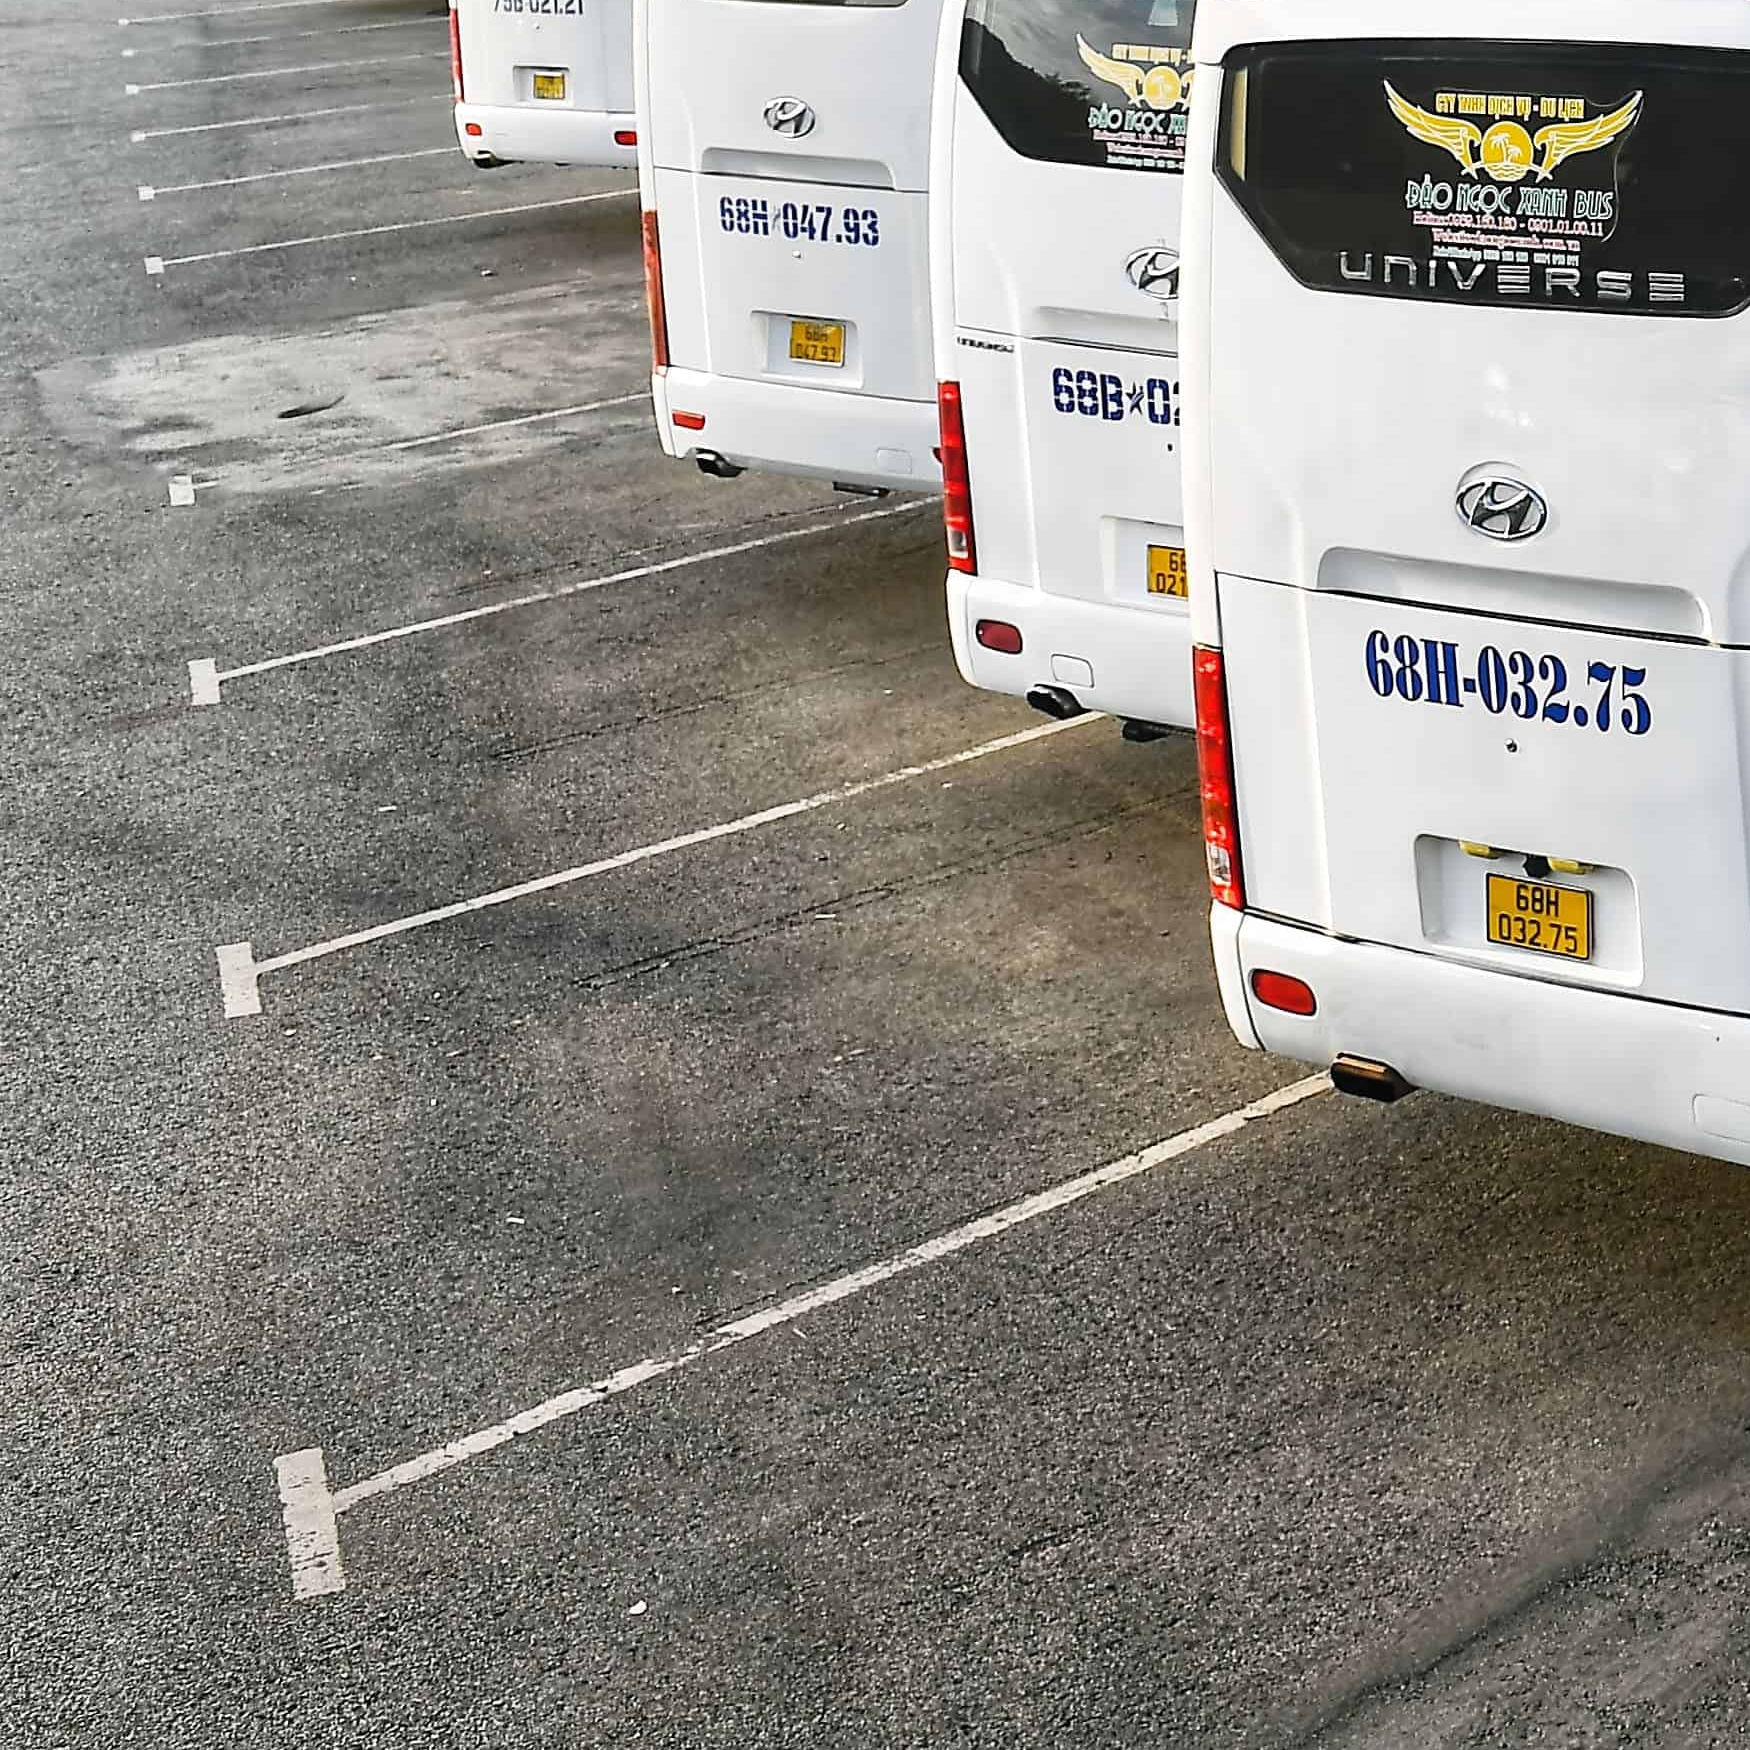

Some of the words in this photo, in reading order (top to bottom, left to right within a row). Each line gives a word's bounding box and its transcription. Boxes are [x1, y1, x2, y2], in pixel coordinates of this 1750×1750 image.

[1405, 173, 1453, 211] ĐẢO
[1456, 183, 1511, 216] NGỌC
[1516, 187, 1568, 218] XANH
[1573, 191, 1614, 220] BUS
[720, 196, 769, 236] 68H
[782, 202, 880, 246] 047.93
[1053, 368, 1124, 421] 68B
[1365, 628, 1651, 736] 68H-032.75
[1516, 883, 1559, 918] 68H
[1498, 913, 1579, 954] 032.75
